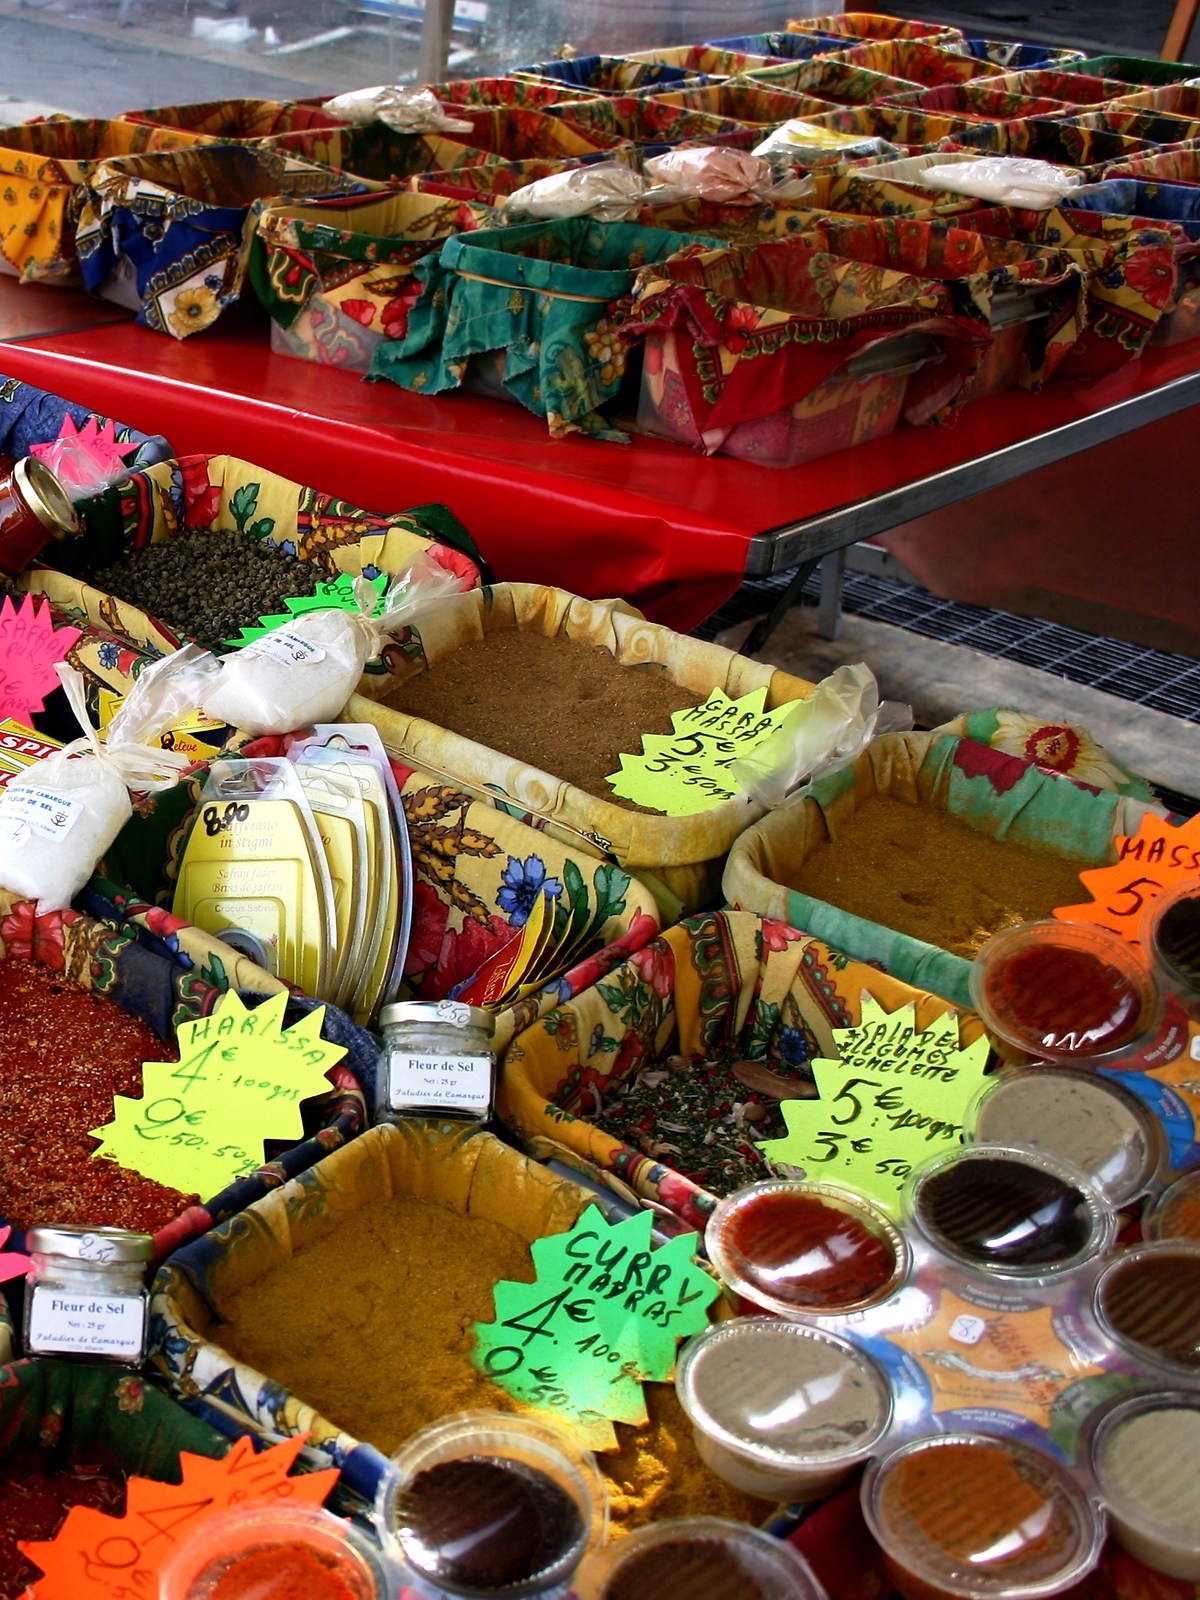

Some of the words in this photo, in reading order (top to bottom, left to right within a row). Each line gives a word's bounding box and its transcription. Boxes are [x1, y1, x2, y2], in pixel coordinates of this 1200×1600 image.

[36, 791, 73, 808] CAMARGUE
[39, 802, 53, 812] SEL
[220, 835, 232, 849] in
[236, 835, 274, 852] stigmi
[216, 867, 249, 881] Safran
[212, 882, 239, 894] Brins
[240, 881, 250, 894] de
[251, 880, 283, 897] safran
[215, 904, 246, 913] Crocus
[247, 903, 279, 913] Sativus
[189, 1013, 326, 1066] HARISSA
[408, 1059, 438, 1071] Fleur
[441, 1061, 455, 1072] de
[457, 1061, 474, 1072] Sel
[445, 1091, 485, 1100] Camargue
[562, 1262, 683, 1328] MADRAS
[51, 1300, 85, 1312] Fleur
[88, 1302, 103, 1313] de
[106, 1303, 125, 1314] Sel
[91, 1336, 136, 1347] Camargue
